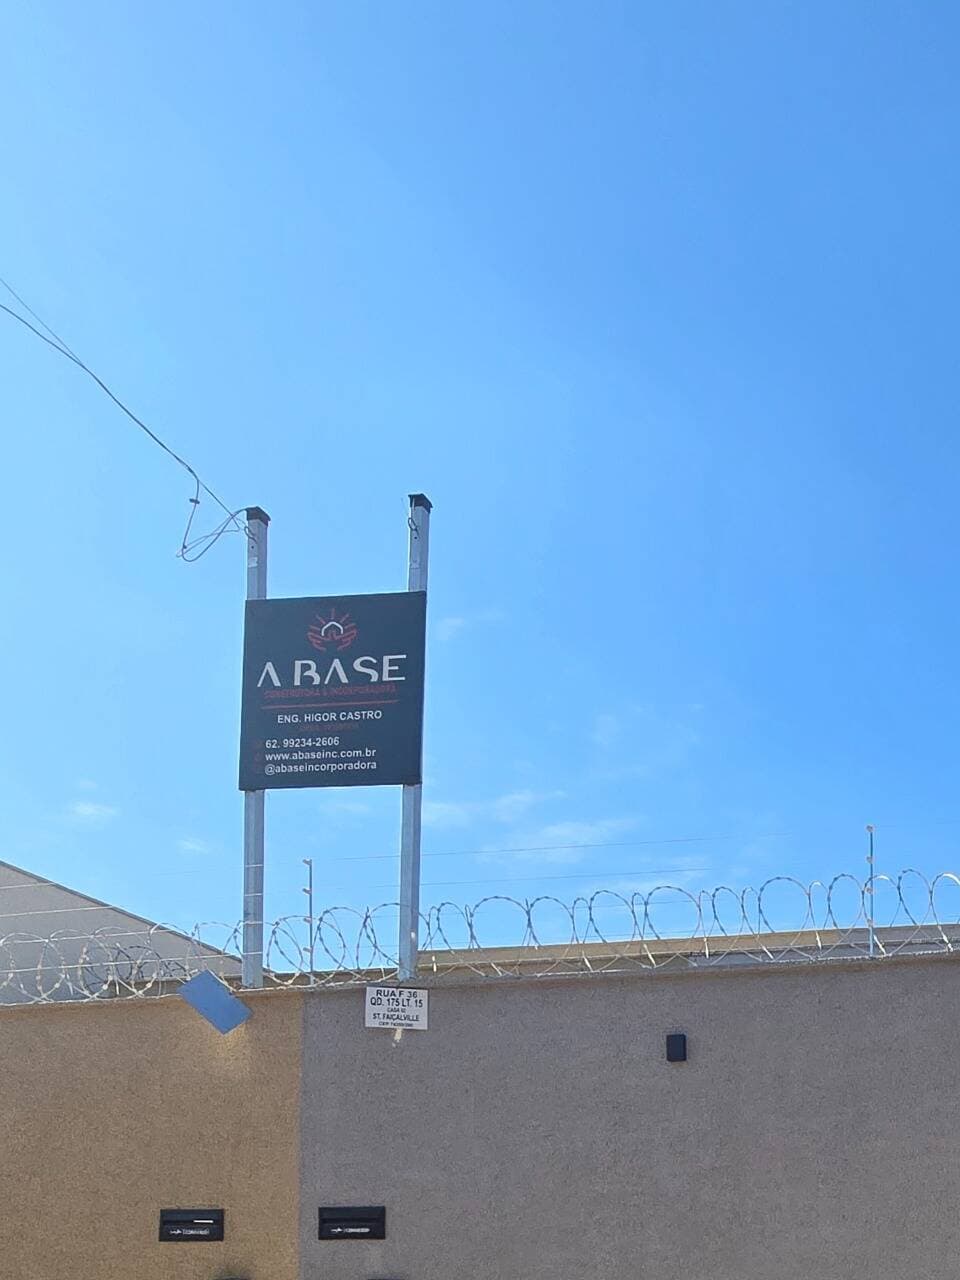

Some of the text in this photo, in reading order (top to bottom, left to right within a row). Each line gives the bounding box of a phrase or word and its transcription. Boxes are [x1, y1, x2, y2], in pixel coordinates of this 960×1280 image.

[277, 710, 383, 723] ENG. HIGOR CASTRO
[265, 736, 340, 749] 62. 99234-2606
[265, 748, 377, 761] www.abaseinc.com.br
[264, 761, 377, 776] @abaseincorporadora
[376, 989, 397, 997] RUA
[398, 990, 405, 998] F
[370, 997, 385, 1006] QD.
[387, 998, 400, 1007] 175
[414, 999, 423, 1008] 15
